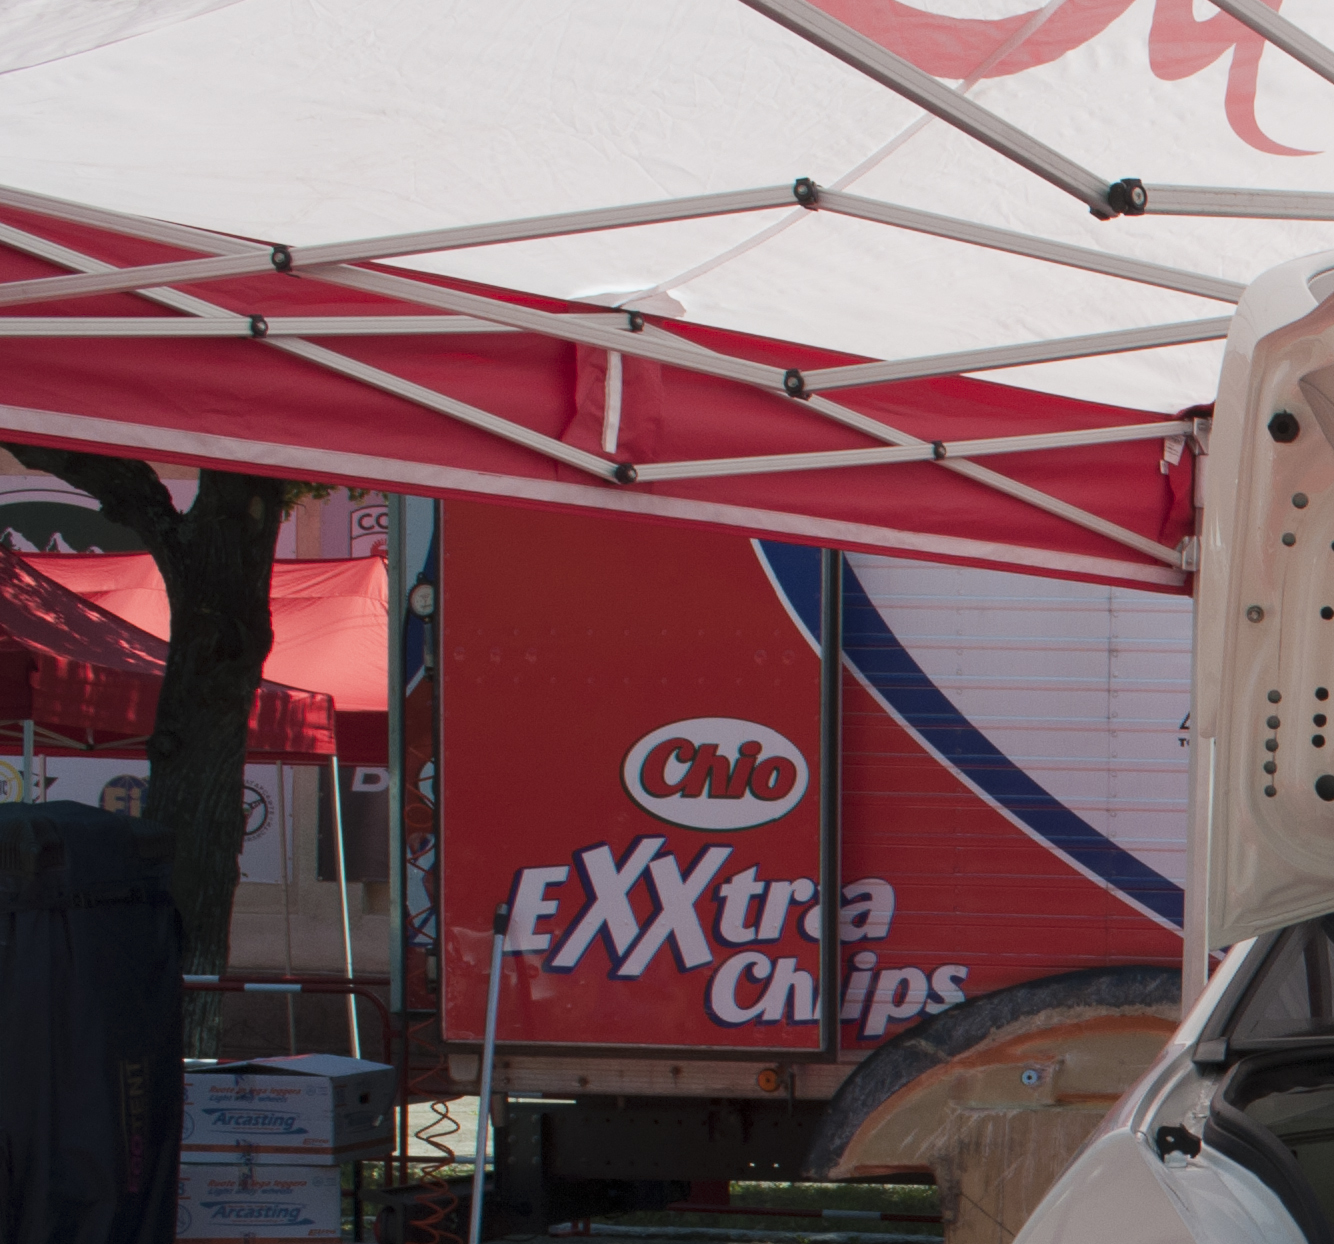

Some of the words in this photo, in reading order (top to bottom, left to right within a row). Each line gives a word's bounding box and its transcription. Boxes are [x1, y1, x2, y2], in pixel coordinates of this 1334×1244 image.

[641, 737, 797, 801] Chio
[705, 950, 969, 1039] Chips
[212, 1112, 297, 1131] Arcasting
[211, 1204, 302, 1223] Arcasting
